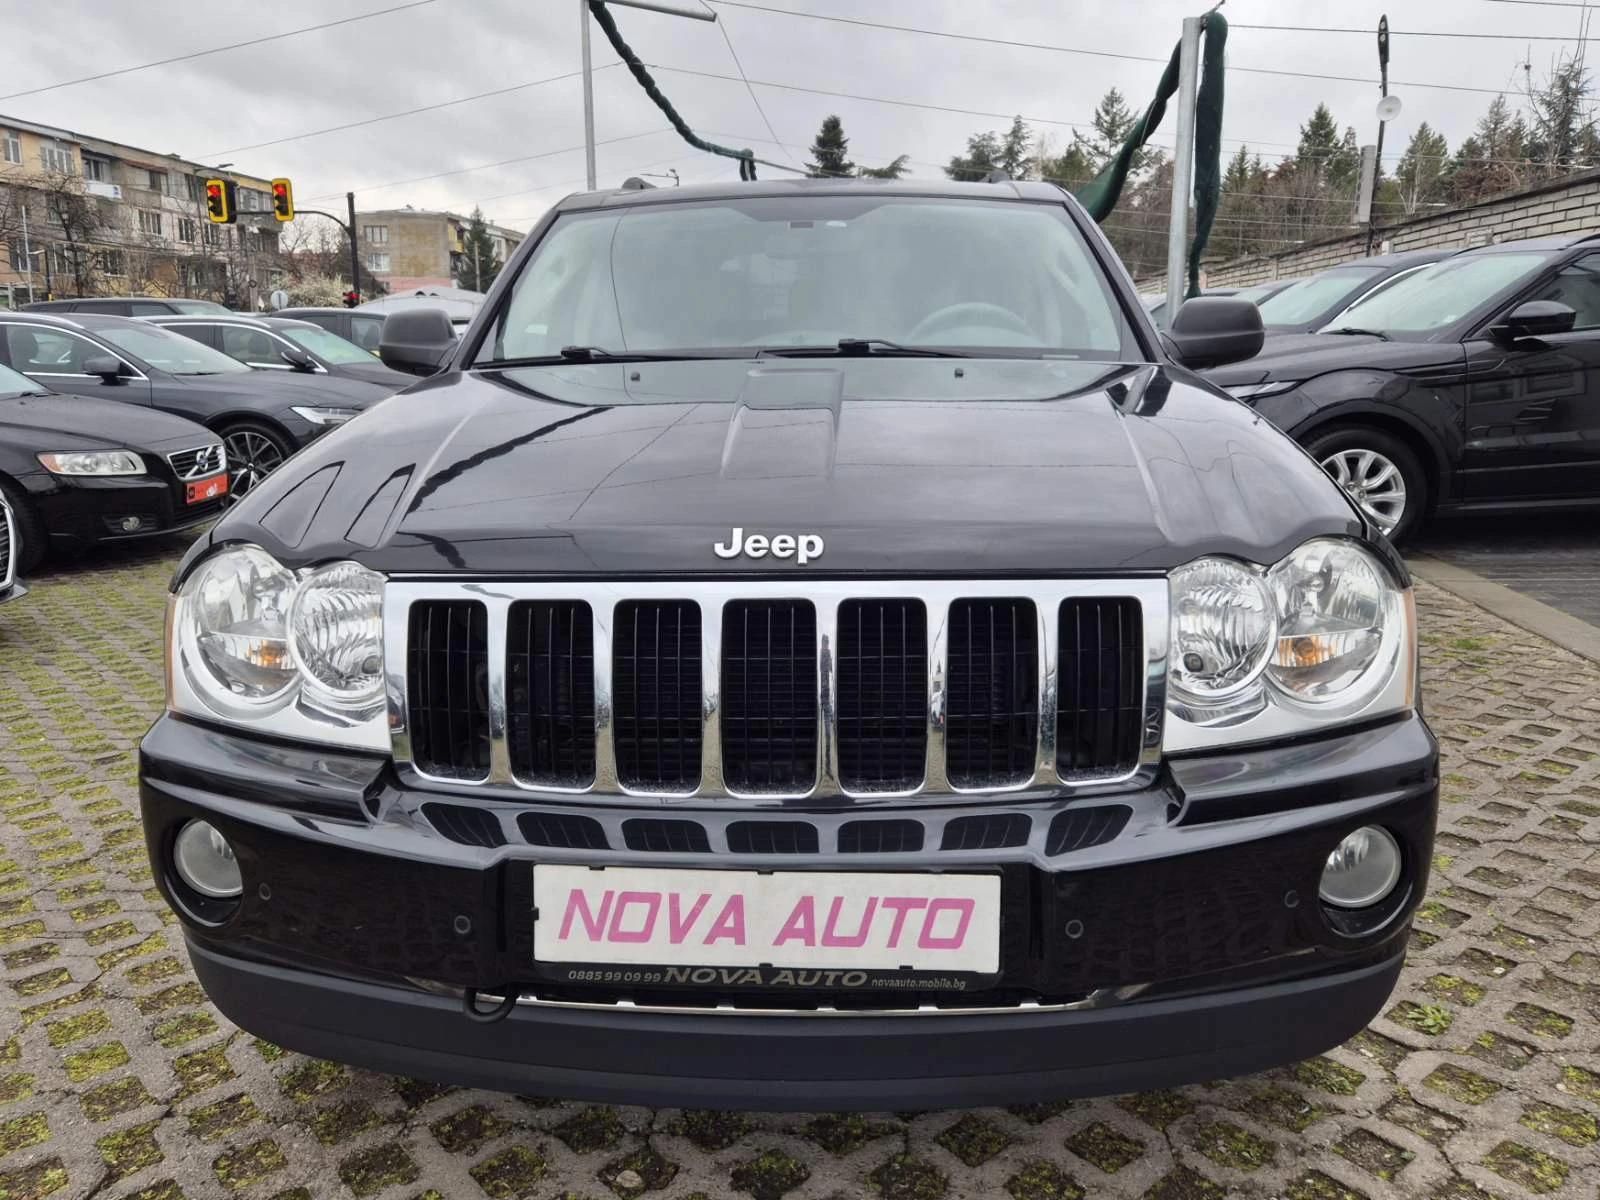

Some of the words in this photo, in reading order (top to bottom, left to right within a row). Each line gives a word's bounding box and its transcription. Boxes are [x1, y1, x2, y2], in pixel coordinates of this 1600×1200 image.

[714, 527, 824, 565] Jeep
[558, 888, 746, 946] NOVA
[772, 895, 976, 950] AUTO
[568, 970, 602, 981] 0885
[664, 967, 763, 985] NOVA
[769, 969, 868, 987] AUTO
[871, 977, 967, 991] novaauto.mobile.bg
